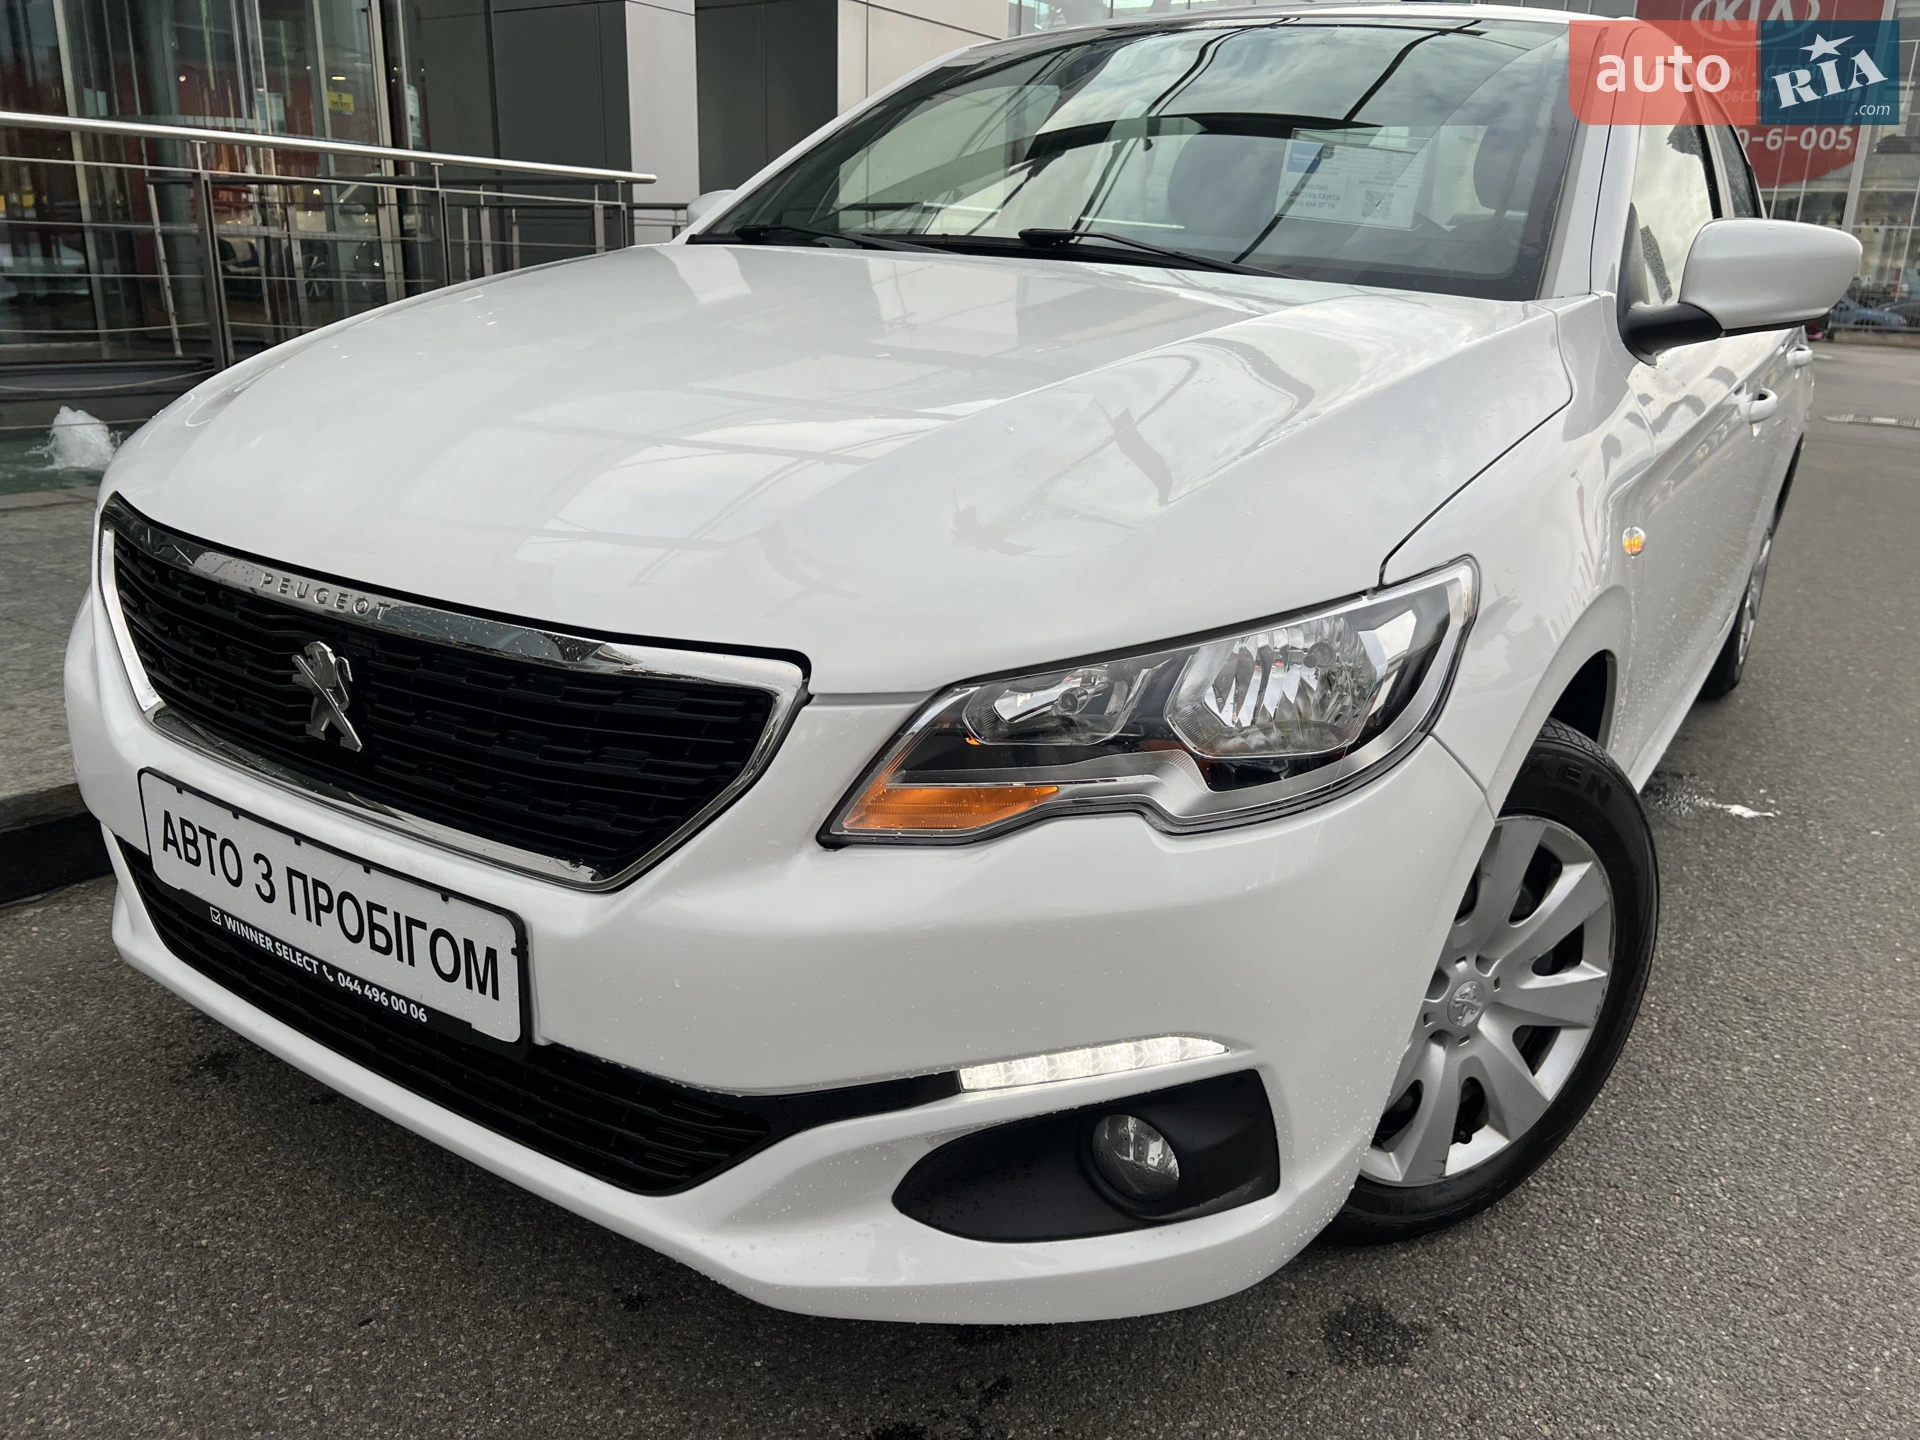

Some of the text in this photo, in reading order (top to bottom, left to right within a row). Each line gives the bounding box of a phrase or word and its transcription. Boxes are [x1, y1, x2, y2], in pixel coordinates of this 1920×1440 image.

[1712, 0, 1795, 33] KIA
[259, 572, 392, 620] PEUGEOT
[162, 810, 243, 888] АВТО
[286, 866, 500, 1001] ПРОБІГОМ
[223, 914, 428, 1023] WINNER SELECT 044 496 00 06
